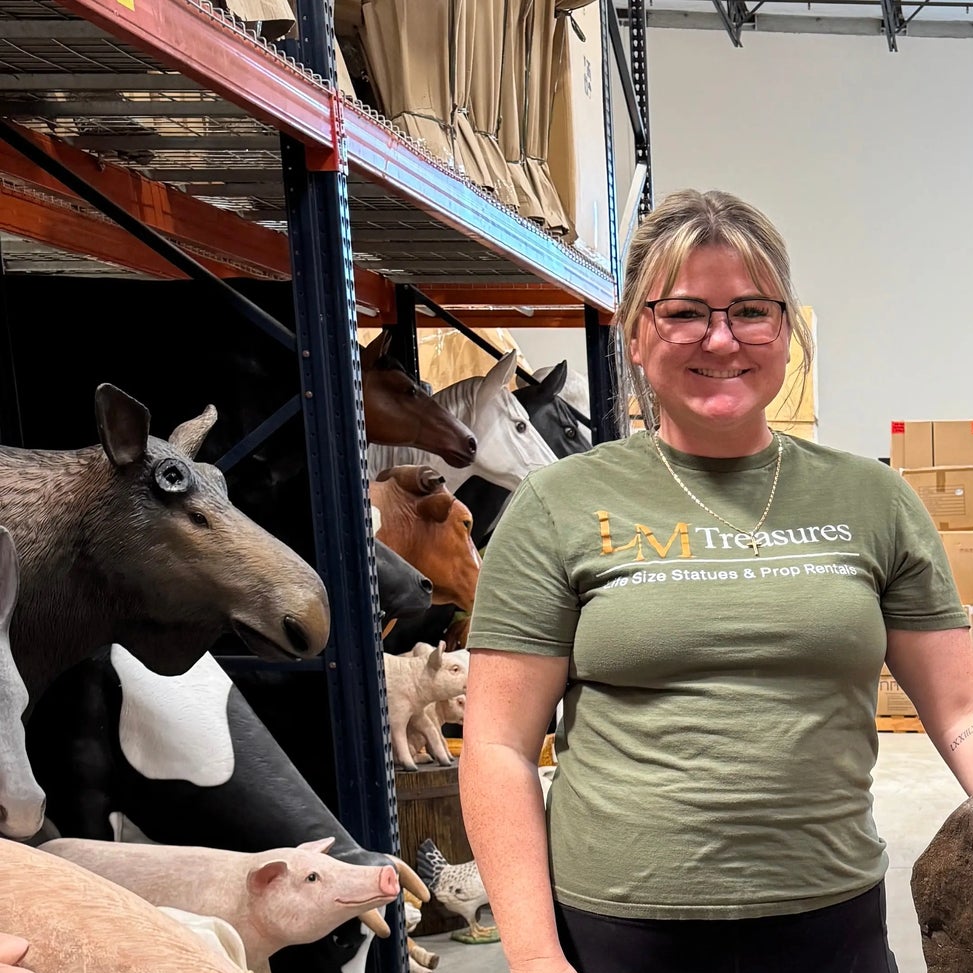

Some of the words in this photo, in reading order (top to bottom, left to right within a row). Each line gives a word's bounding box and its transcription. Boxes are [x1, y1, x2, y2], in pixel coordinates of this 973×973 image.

[592, 510, 696, 562] LM
[695, 523, 852, 549] Treasures
[632, 571, 667, 585] Size
[671, 569, 738, 581] Statues
[743, 568, 757, 579] &
[760, 565, 801, 578] Prop
[803, 562, 858, 576] Rentals
